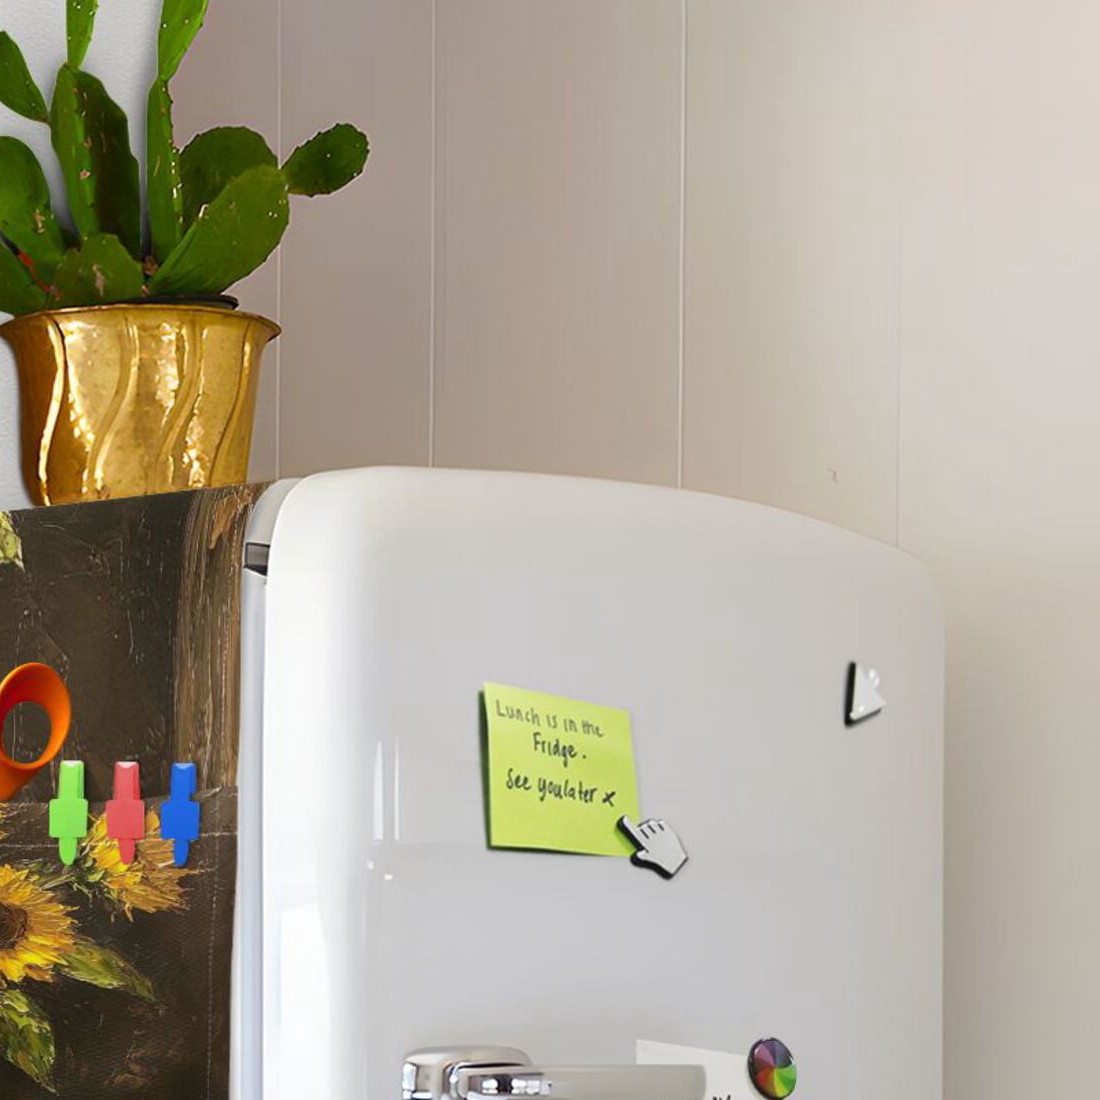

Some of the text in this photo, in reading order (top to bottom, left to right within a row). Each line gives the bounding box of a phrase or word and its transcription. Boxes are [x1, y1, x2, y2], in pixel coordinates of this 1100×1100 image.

[496, 700, 540, 727] Lunch
[563, 718, 578, 733] in
[582, 720, 603, 737] the
[506, 768, 532, 791] See
